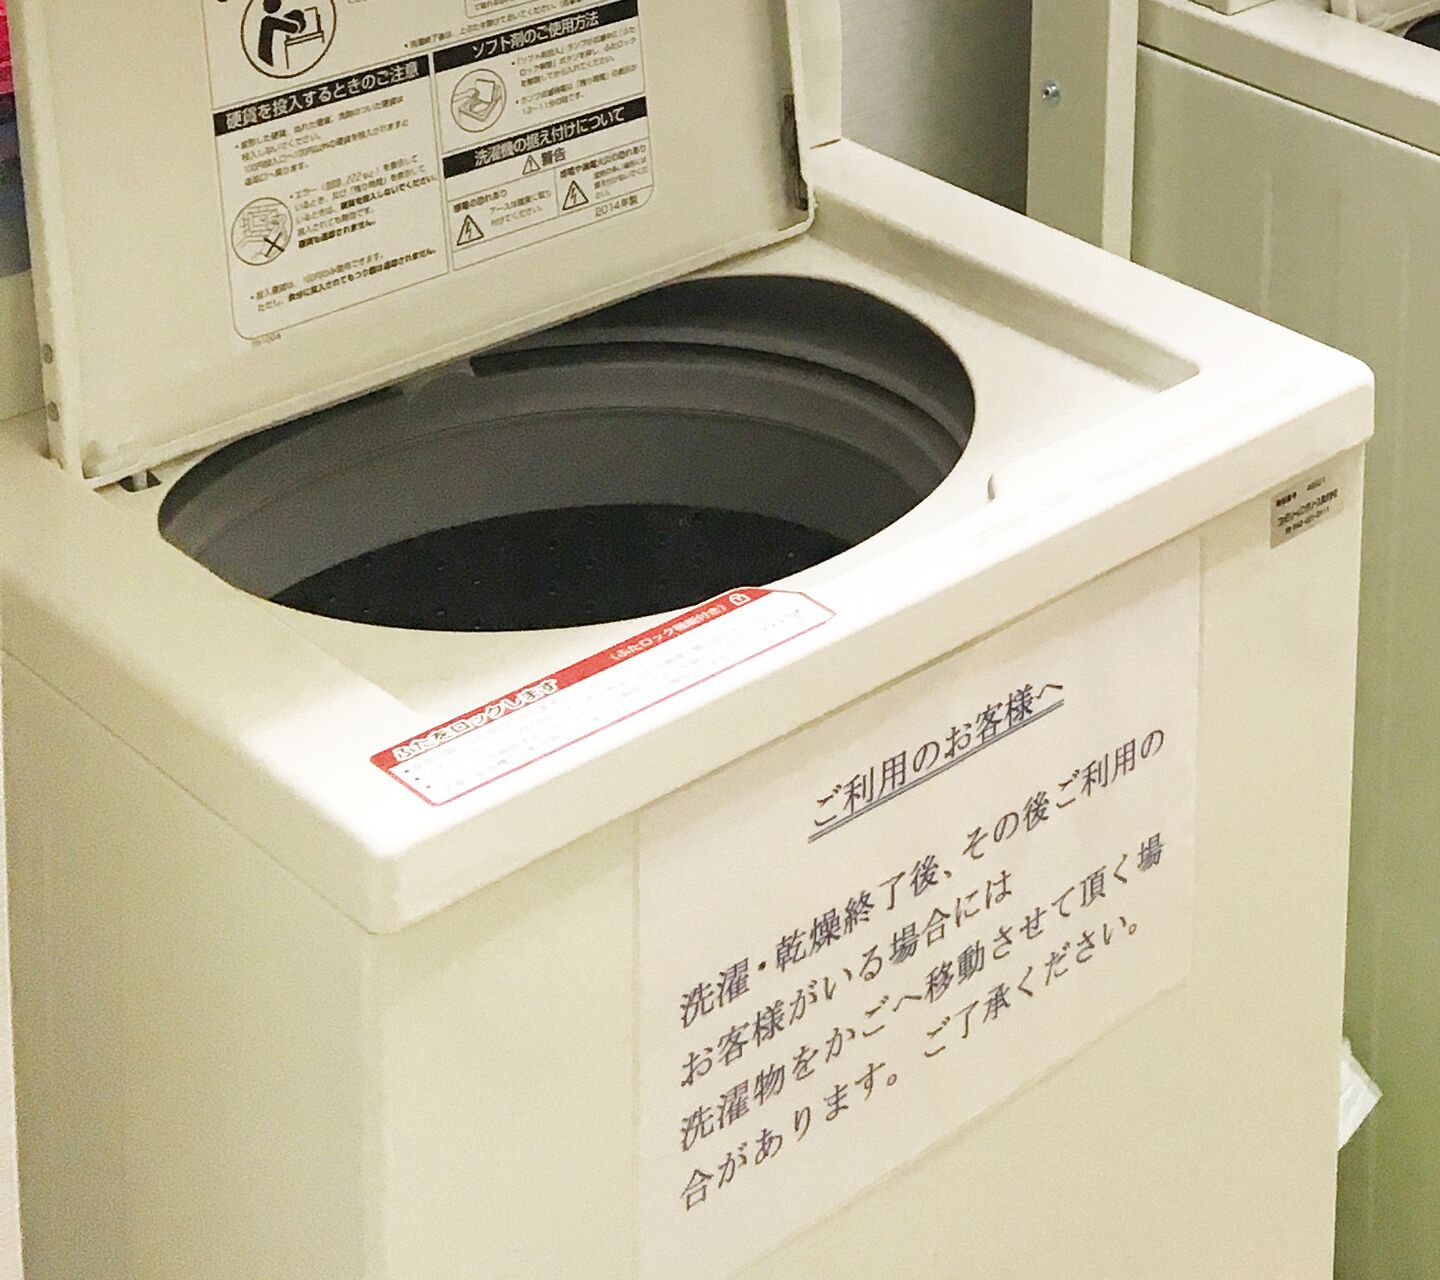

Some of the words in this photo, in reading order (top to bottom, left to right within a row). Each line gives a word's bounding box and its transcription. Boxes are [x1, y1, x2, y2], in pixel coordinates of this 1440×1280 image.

[225, 64, 420, 130] 硬貨を投入するときのご注意
[472, 11, 600, 59] ソフト剤のご使用方法
[815, 679, 1065, 828] ご利用のお客様へ
[680, 728, 1166, 1028] 洗濯・乾燥終了後、その後ご利用の
[681, 868, 1015, 1087] お客様がいる場合には
[680, 833, 1164, 1153] 洗濯物をかごへ移動させて頂く場
[680, 918, 1140, 1212] 合があります。ご了承ください。
